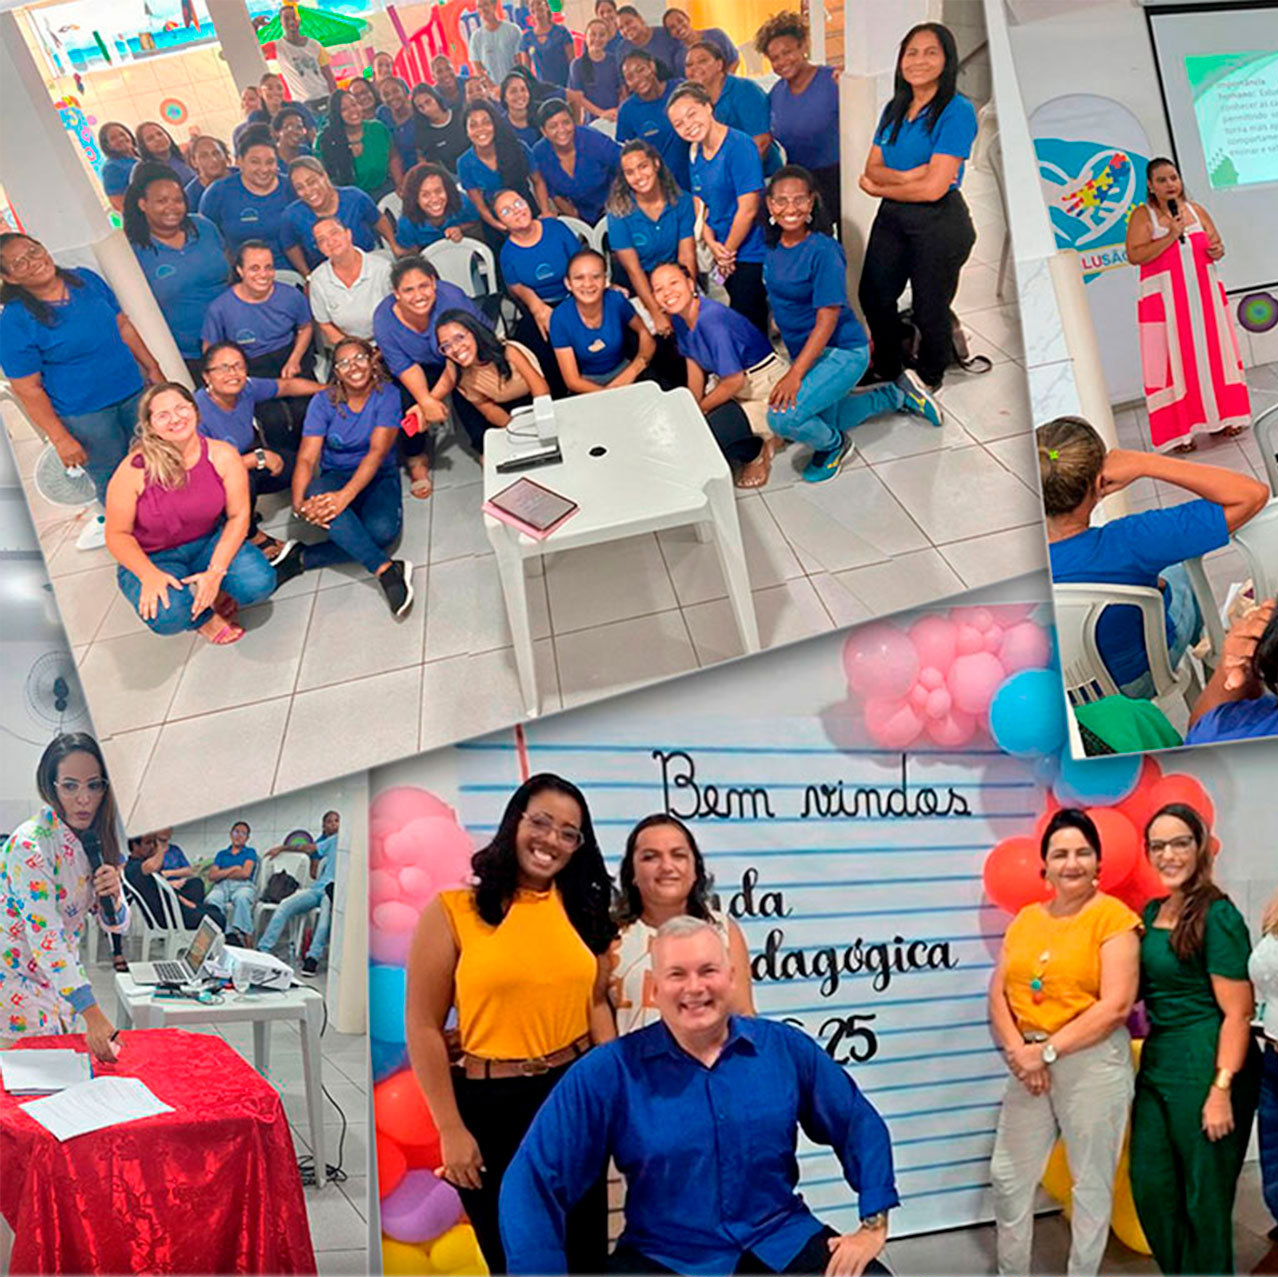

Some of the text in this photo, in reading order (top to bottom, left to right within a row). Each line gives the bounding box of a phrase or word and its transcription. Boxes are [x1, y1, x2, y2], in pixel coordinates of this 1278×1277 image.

[652, 750, 973, 819] Bem vindos
[751, 929, 959, 998] dagógica
